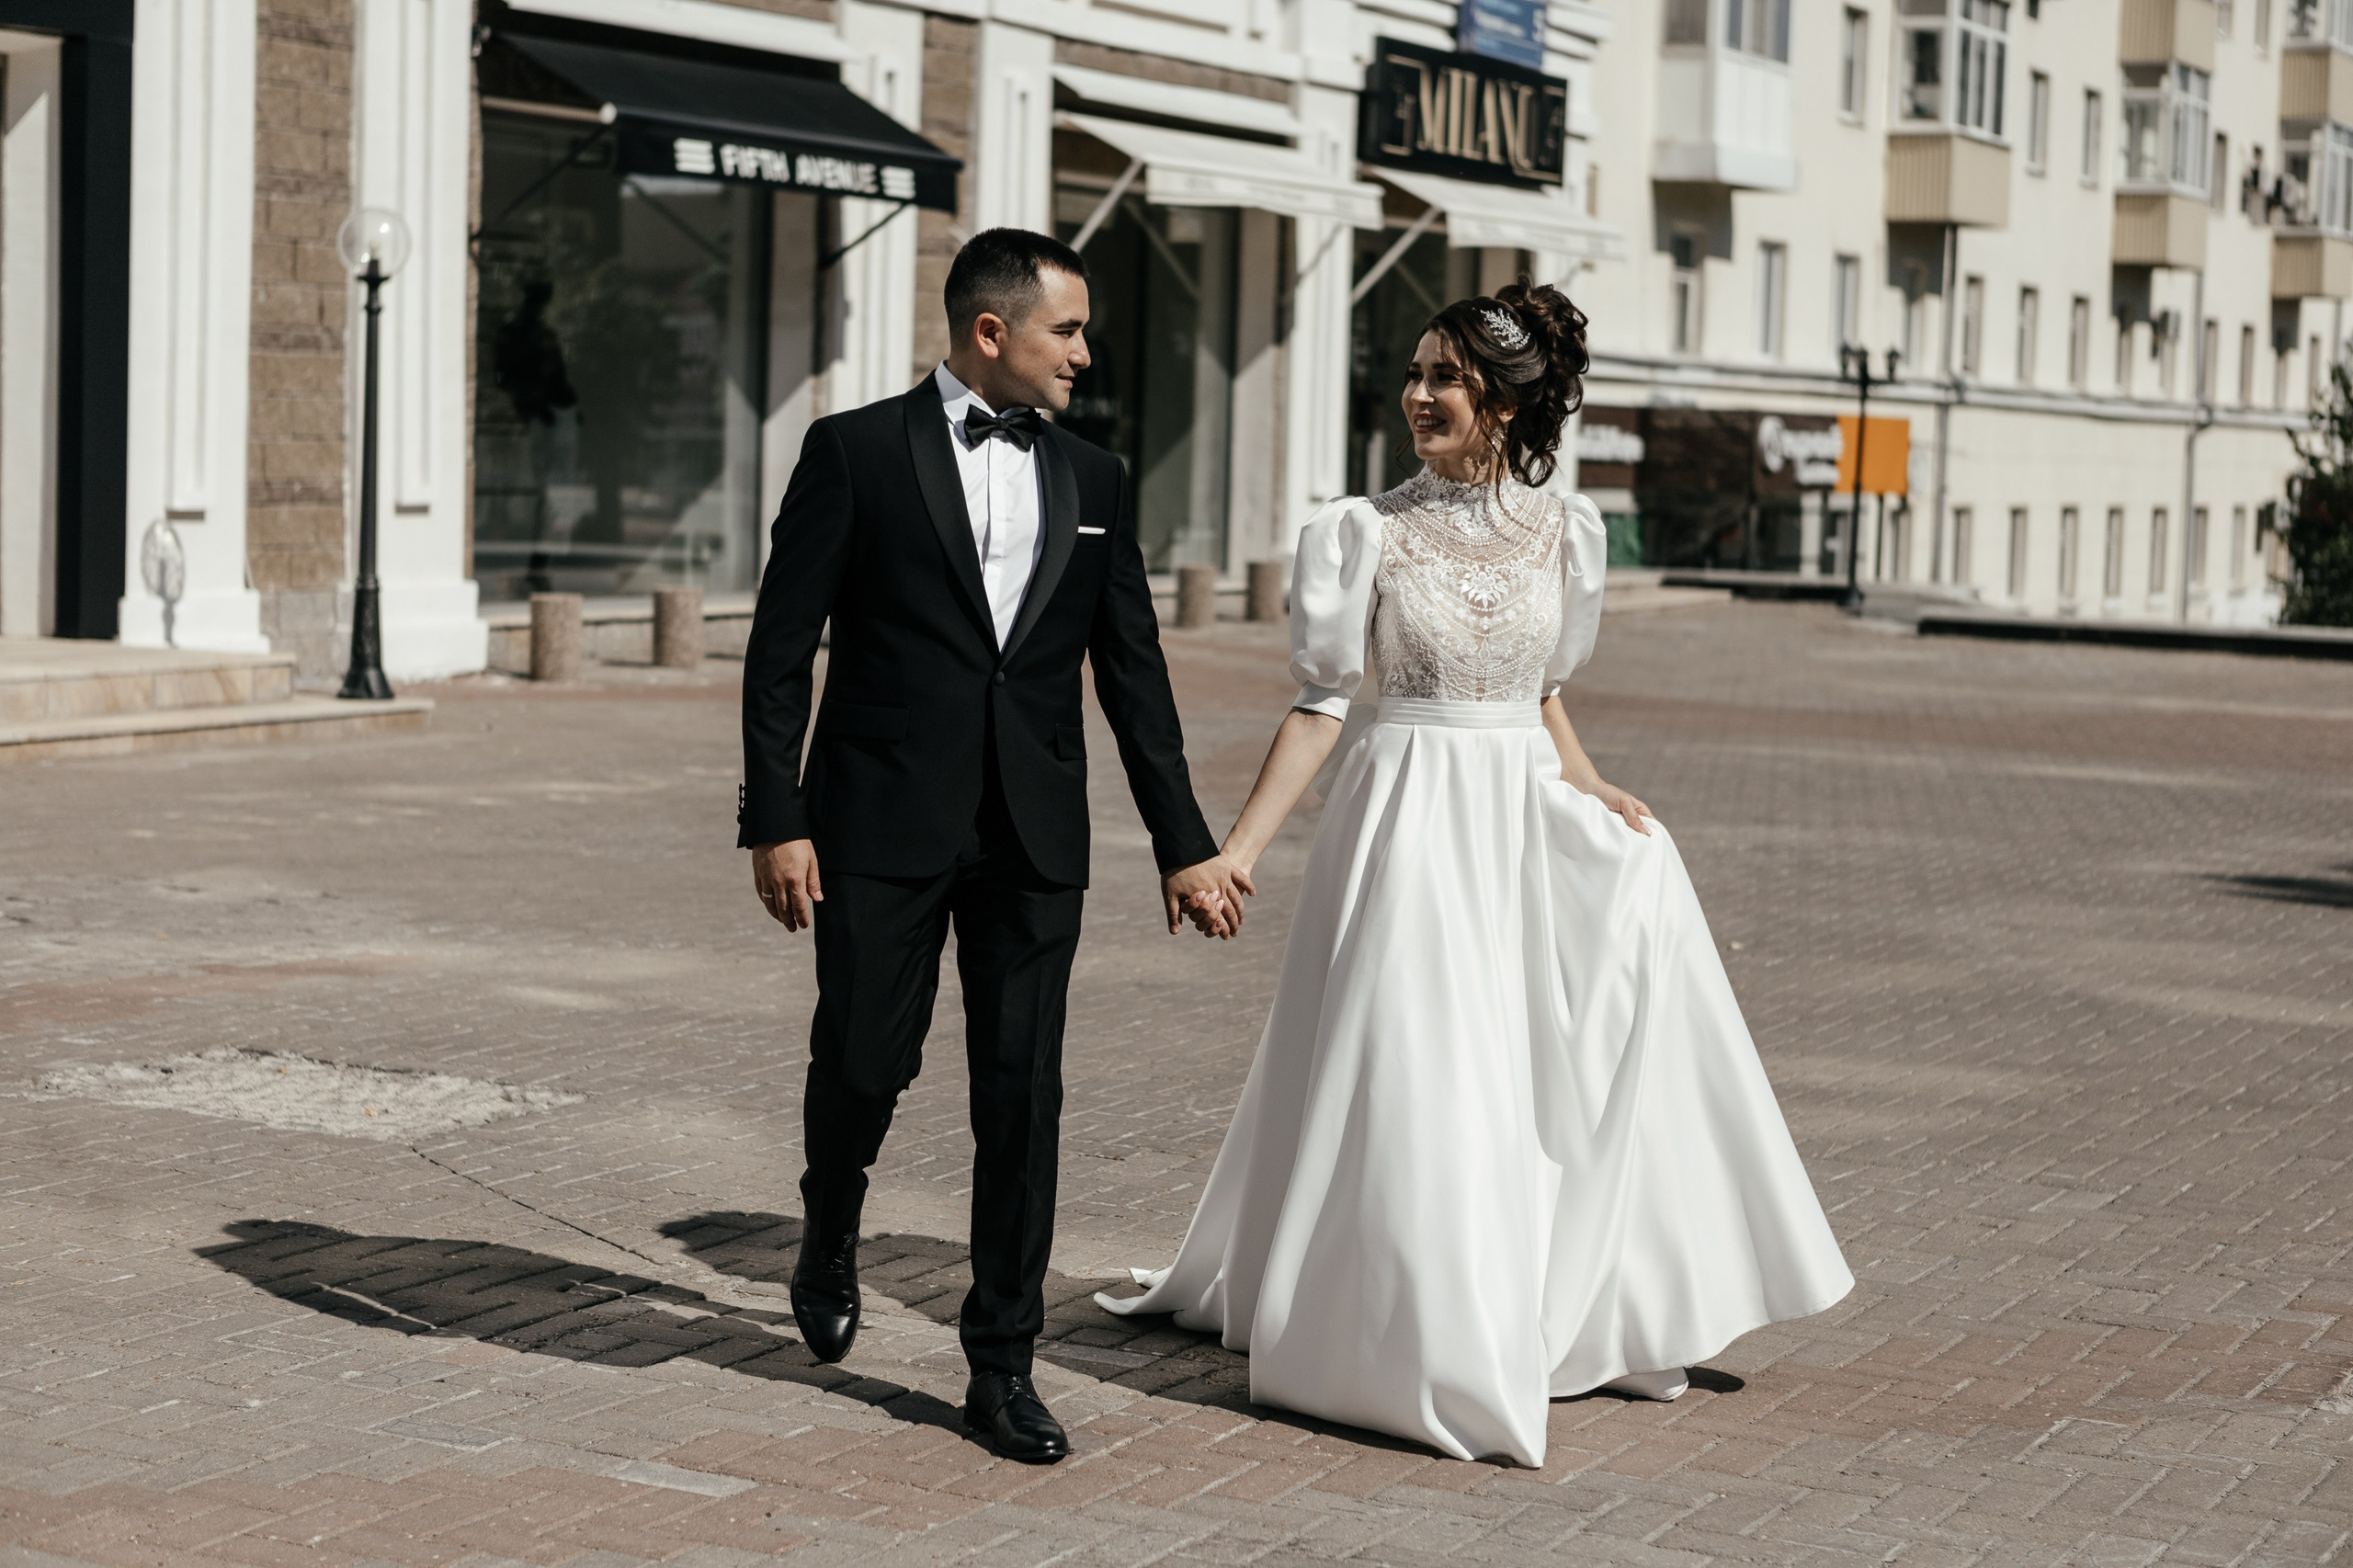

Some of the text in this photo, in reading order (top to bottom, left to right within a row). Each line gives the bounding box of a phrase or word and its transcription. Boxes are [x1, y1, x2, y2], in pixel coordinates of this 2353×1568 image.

[1415, 62, 1540, 173] MILANO
[721, 144, 878, 194] FIFTH AVENUE
